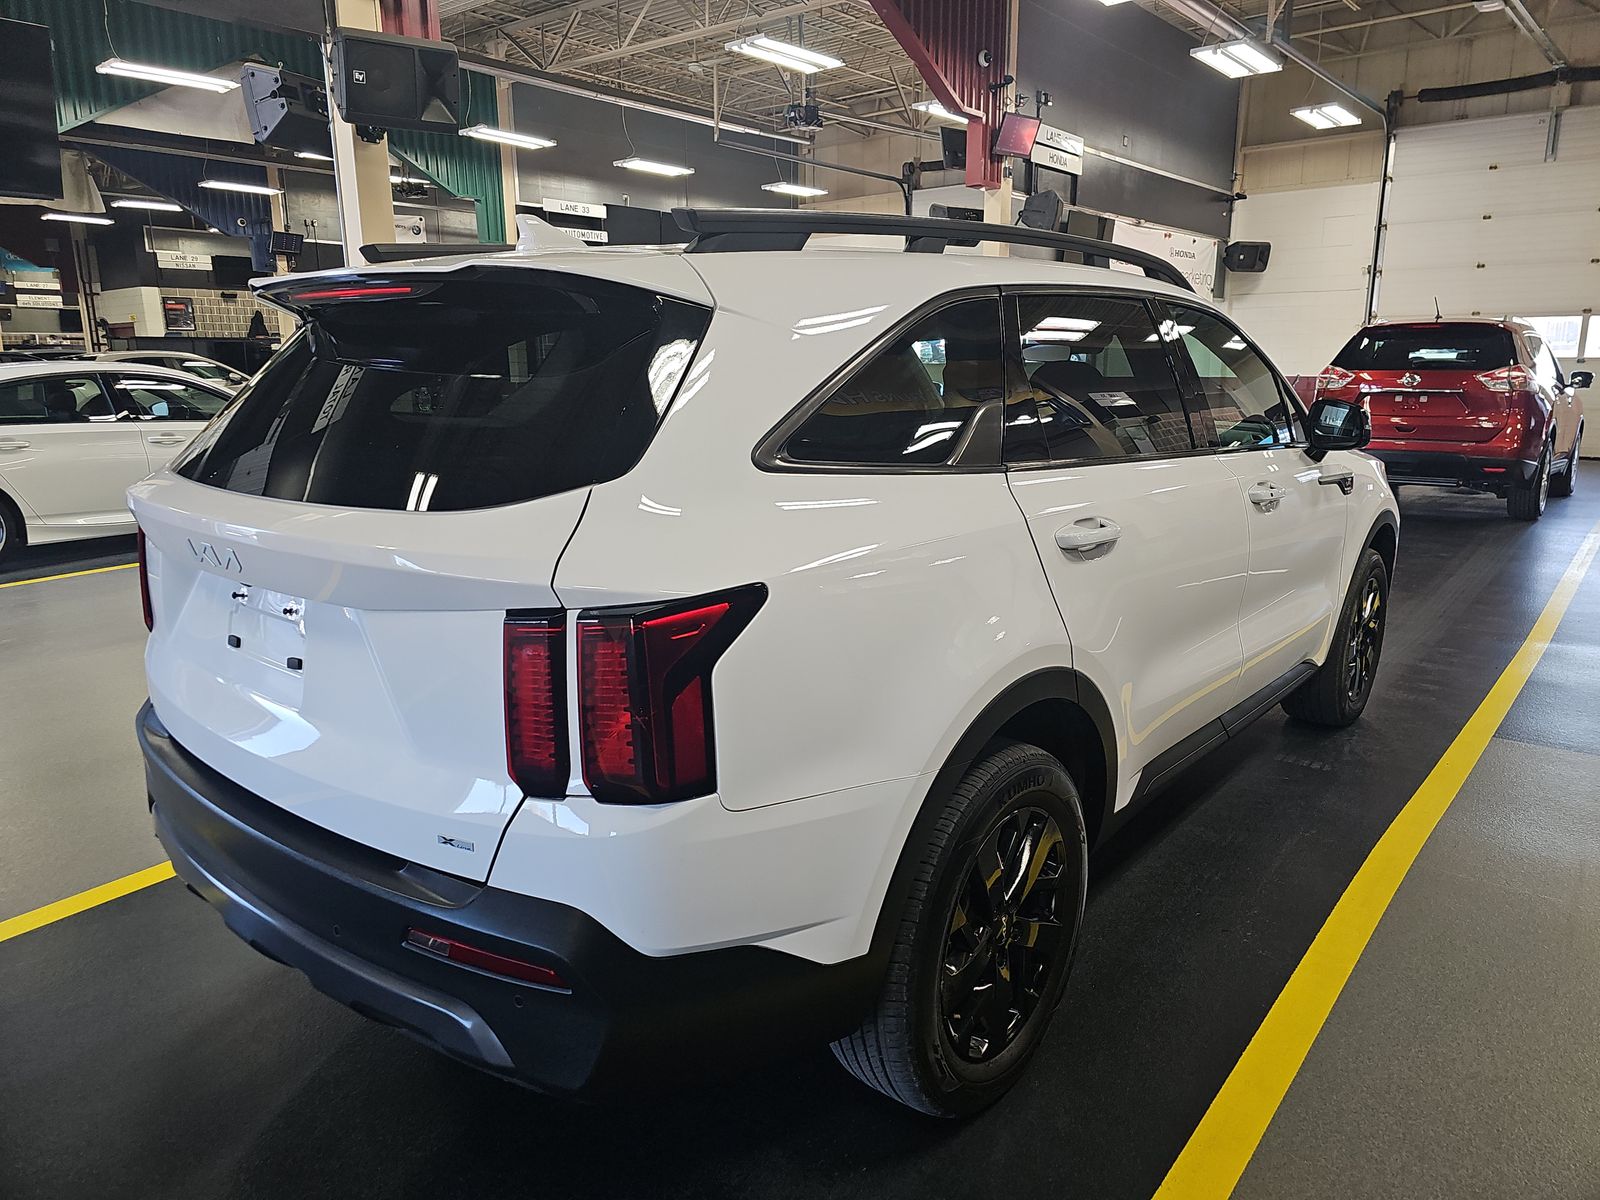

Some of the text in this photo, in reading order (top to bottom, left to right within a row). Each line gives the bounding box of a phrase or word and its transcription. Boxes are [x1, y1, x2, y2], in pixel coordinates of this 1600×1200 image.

[1048, 151, 1068, 168] HONDA
[560, 203, 590, 214] LANE 33
[170, 253, 188, 261] LANE
[1173, 248, 1196, 260] HONDA
[1180, 267, 1213, 291] arketing
